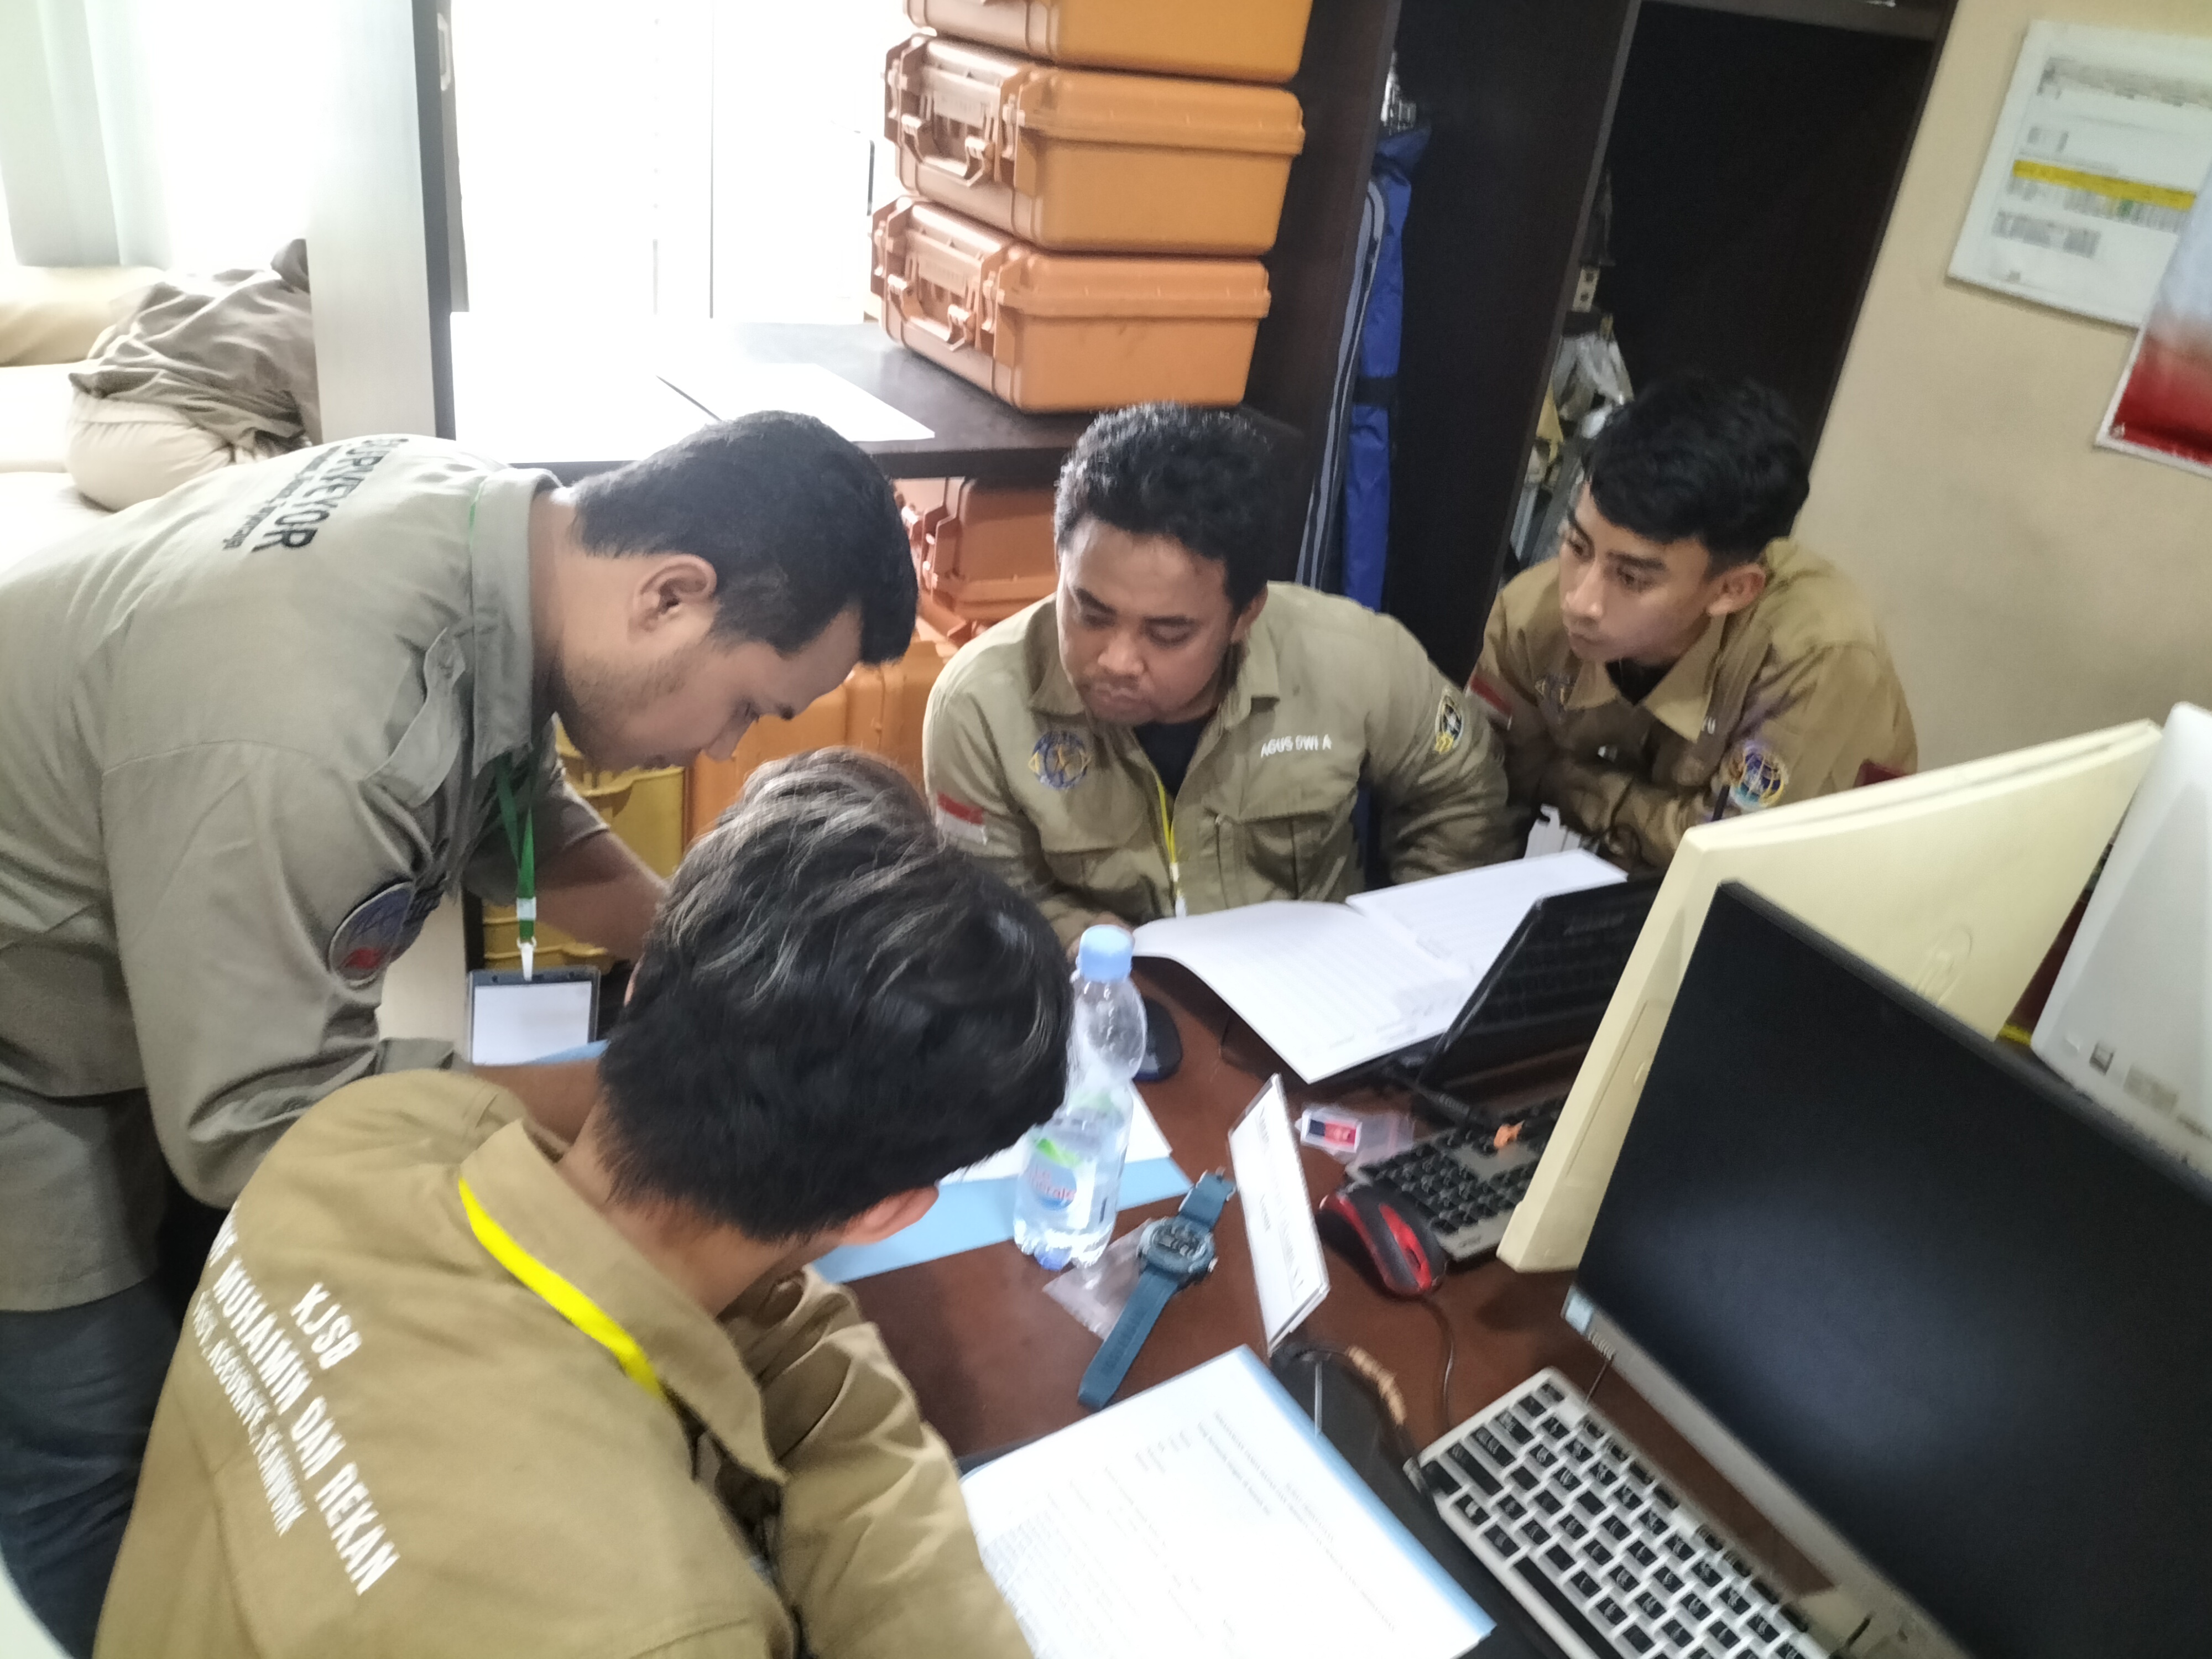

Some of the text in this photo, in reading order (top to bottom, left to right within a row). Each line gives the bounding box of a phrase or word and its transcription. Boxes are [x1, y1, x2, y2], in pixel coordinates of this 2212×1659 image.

[1260, 733, 1332, 758] AGUS DWI A
[290, 1281, 363, 1370] KJSB
[212, 1255, 401, 1596] MUHAIMIN DAN REKAN
